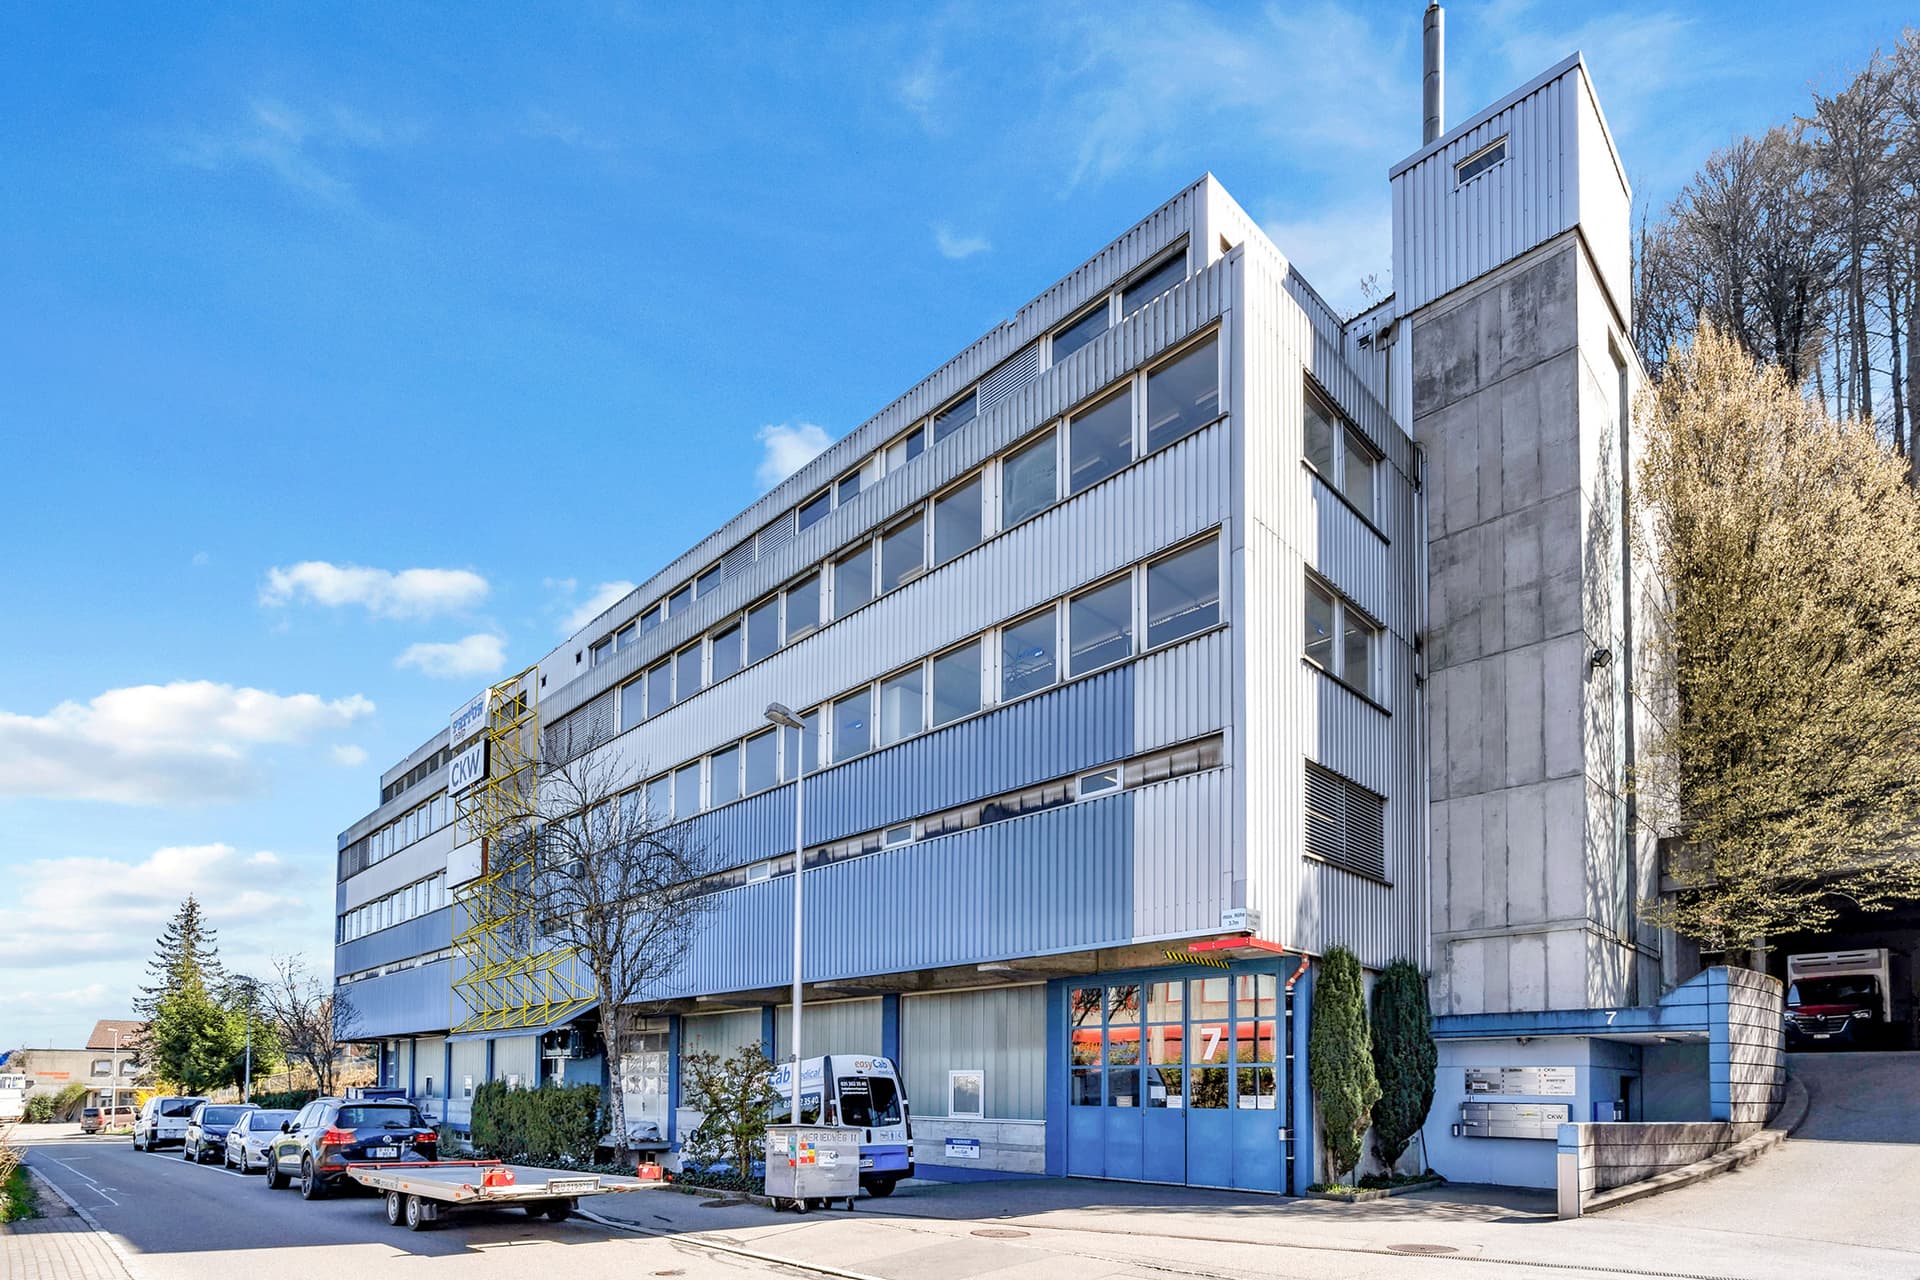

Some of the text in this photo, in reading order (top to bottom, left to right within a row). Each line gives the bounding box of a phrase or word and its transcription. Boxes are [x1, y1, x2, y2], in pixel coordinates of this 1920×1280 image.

[451, 749, 480, 788] CKW
[1604, 1011, 1617, 1025] 7
[1200, 1027, 1221, 1061] 7
